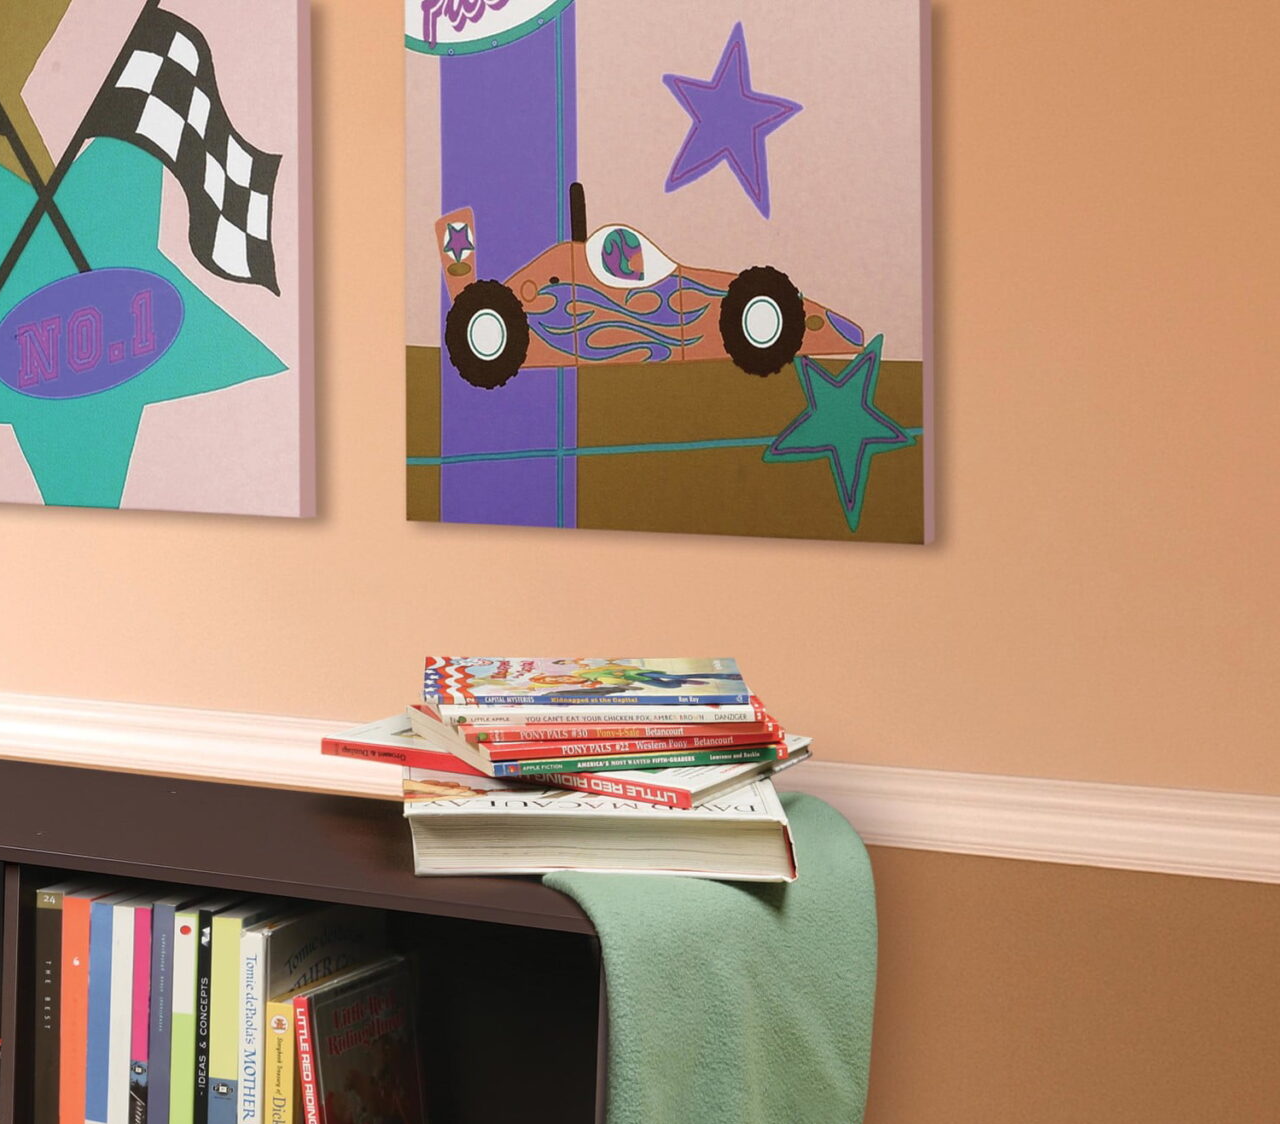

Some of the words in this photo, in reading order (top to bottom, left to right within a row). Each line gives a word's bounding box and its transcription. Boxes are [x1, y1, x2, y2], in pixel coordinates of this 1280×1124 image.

[17, 289, 156, 389] NO.1
[485, 696, 506, 704] CAPITAL
[506, 696, 535, 704] MYSTERIES
[714, 713, 748, 721] DANZIGER
[520, 730, 548, 740] PONY
[548, 729, 568, 739] PALS
[645, 727, 684, 736] Betancourt
[562, 745, 590, 755] PONY
[590, 744, 612, 753] PALS
[615, 743, 630, 751] #22
[636, 741, 667, 750] Western
[669, 740, 688, 749] Pony
[693, 736, 734, 746] Betancourt
[577, 760, 609, 768] AMERICA'S
[591, 778, 623, 794] RED
[626, 785, 677, 804] LITTLE
[424, 800, 637, 810] MACAULAY
[43, 895, 56, 904] 24
[44, 960, 52, 984] THE
[246, 954, 257, 991] Tomie
[199, 977, 209, 1035] CONCEPTS
[296, 1008, 309, 1051] LITTLE
[198, 1056, 206, 1088] IDEAS
[301, 1054, 312, 1081] RED
[242, 1049, 257, 1120] MOTHER
